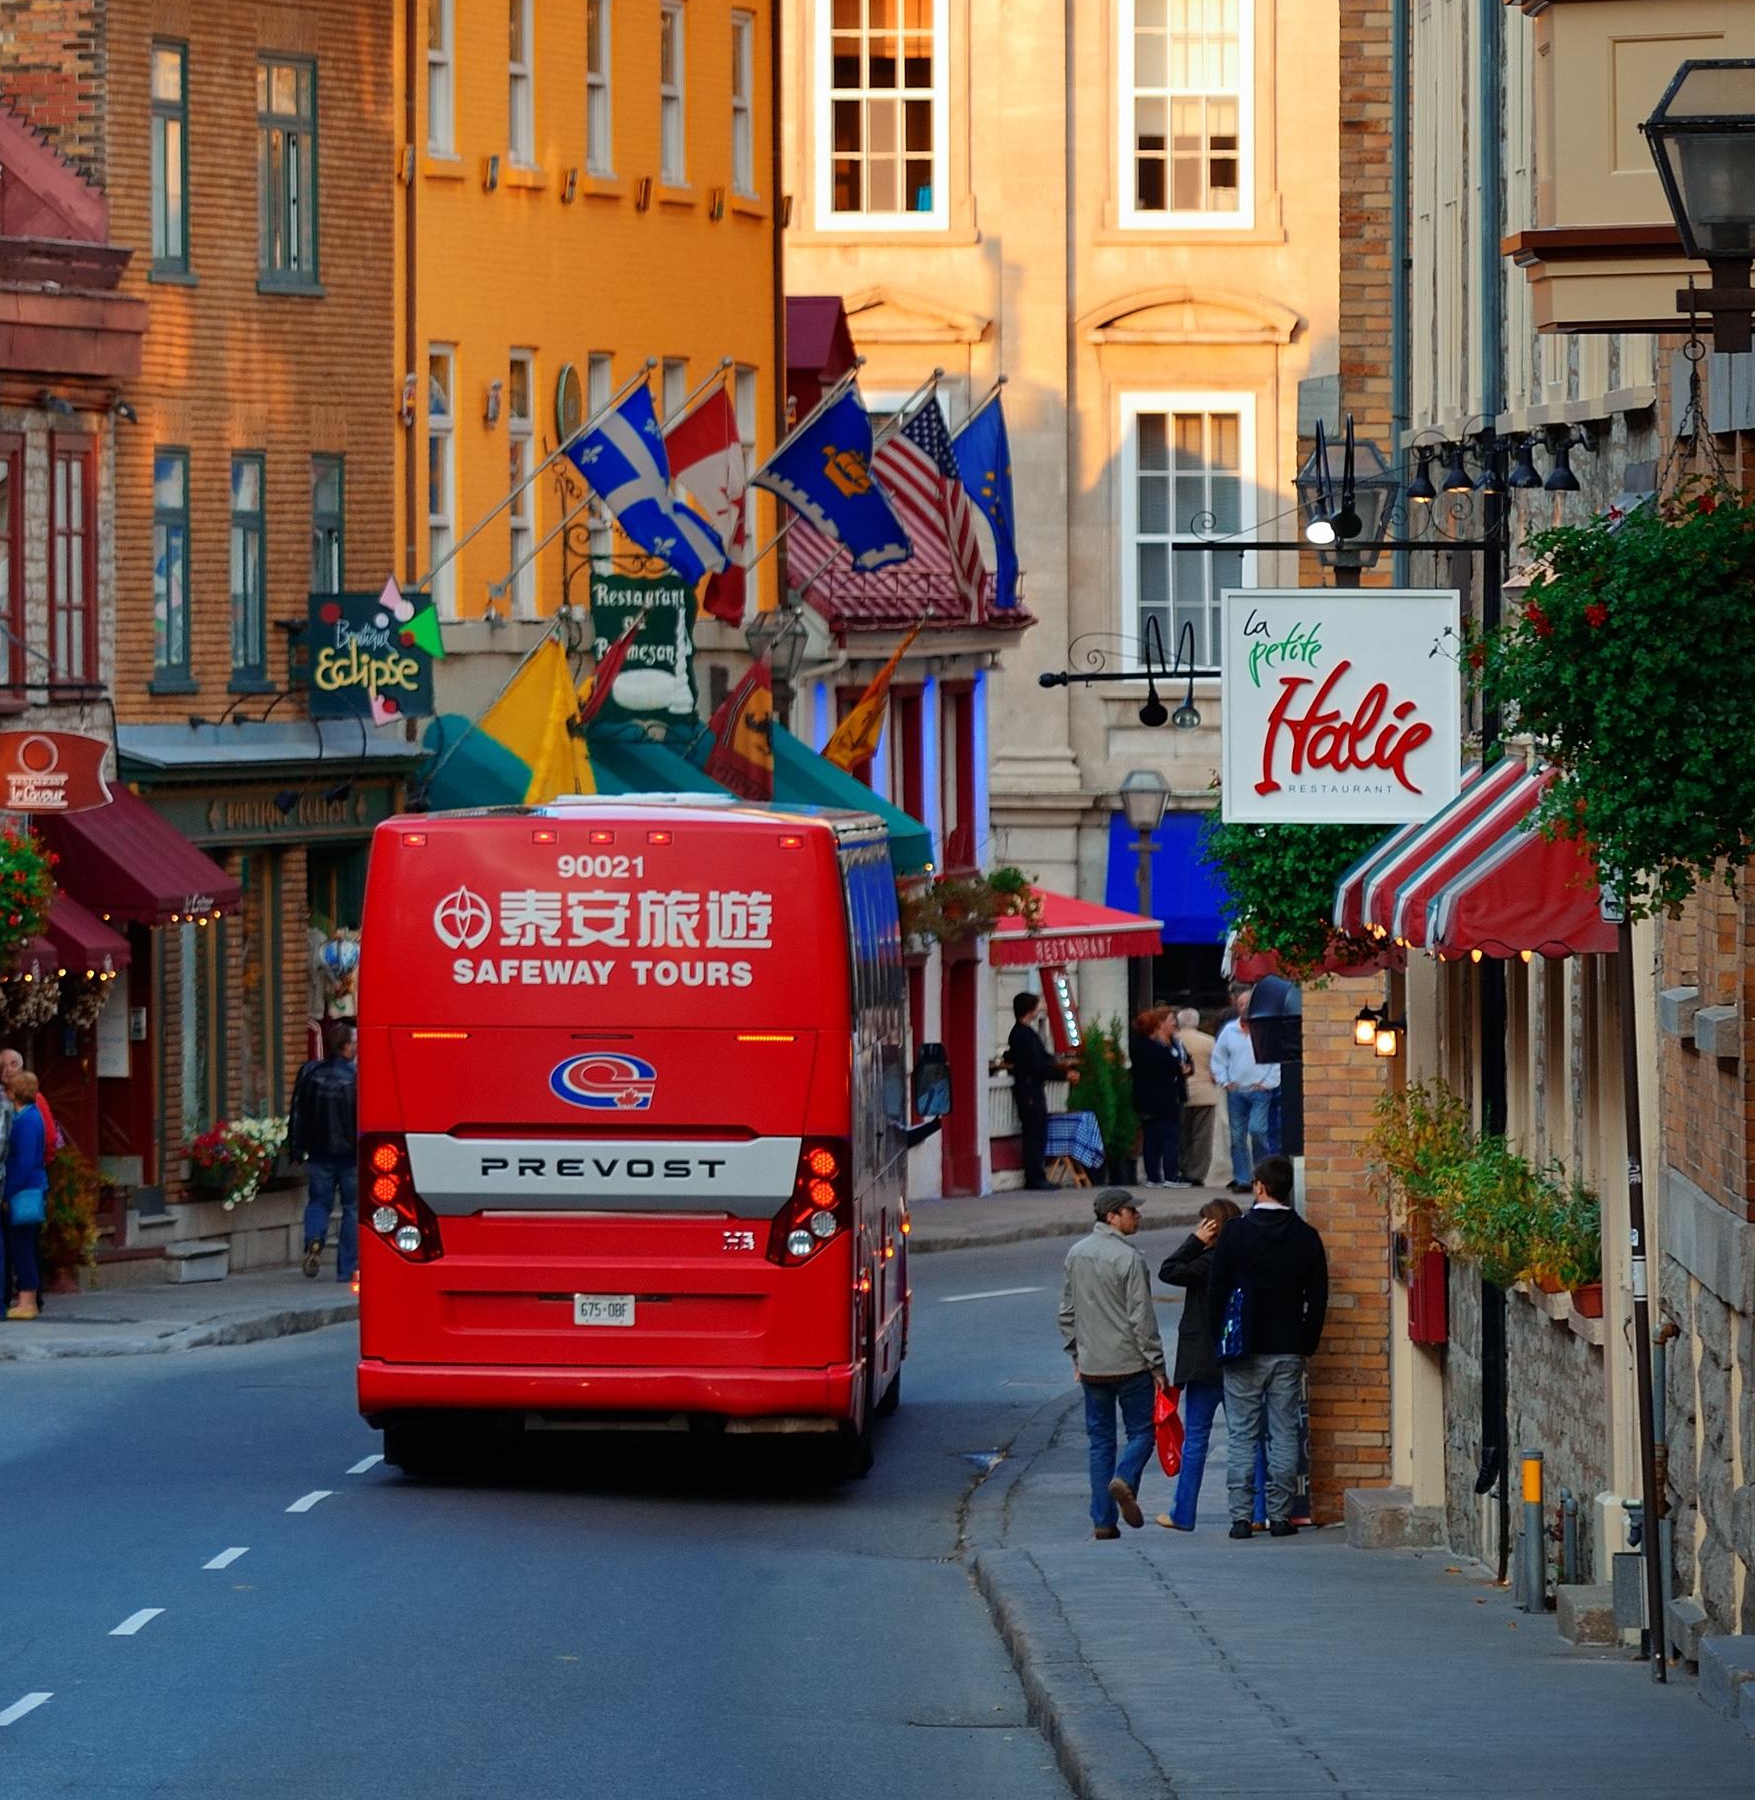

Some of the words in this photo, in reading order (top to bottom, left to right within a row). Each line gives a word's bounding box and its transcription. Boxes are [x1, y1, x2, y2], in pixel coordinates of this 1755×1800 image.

[593, 584, 685, 608] Restaurant
[336, 618, 397, 652] Boutique
[1243, 609, 1271, 638] La
[315, 638, 419, 699] Eclipse
[1248, 622, 1323, 688] petite
[1254, 659, 1434, 796] Italie
[1288, 784, 1393, 794] RESTAURANT
[557, 855, 646, 879] 90021
[500, 888, 773, 949] 泰安旅遊
[1035, 936, 1113, 962] RESTAURANT
[453, 959, 615, 985] SAFEWAY
[631, 960, 754, 988] TOURS
[481, 1157, 727, 1179] PREVOST
